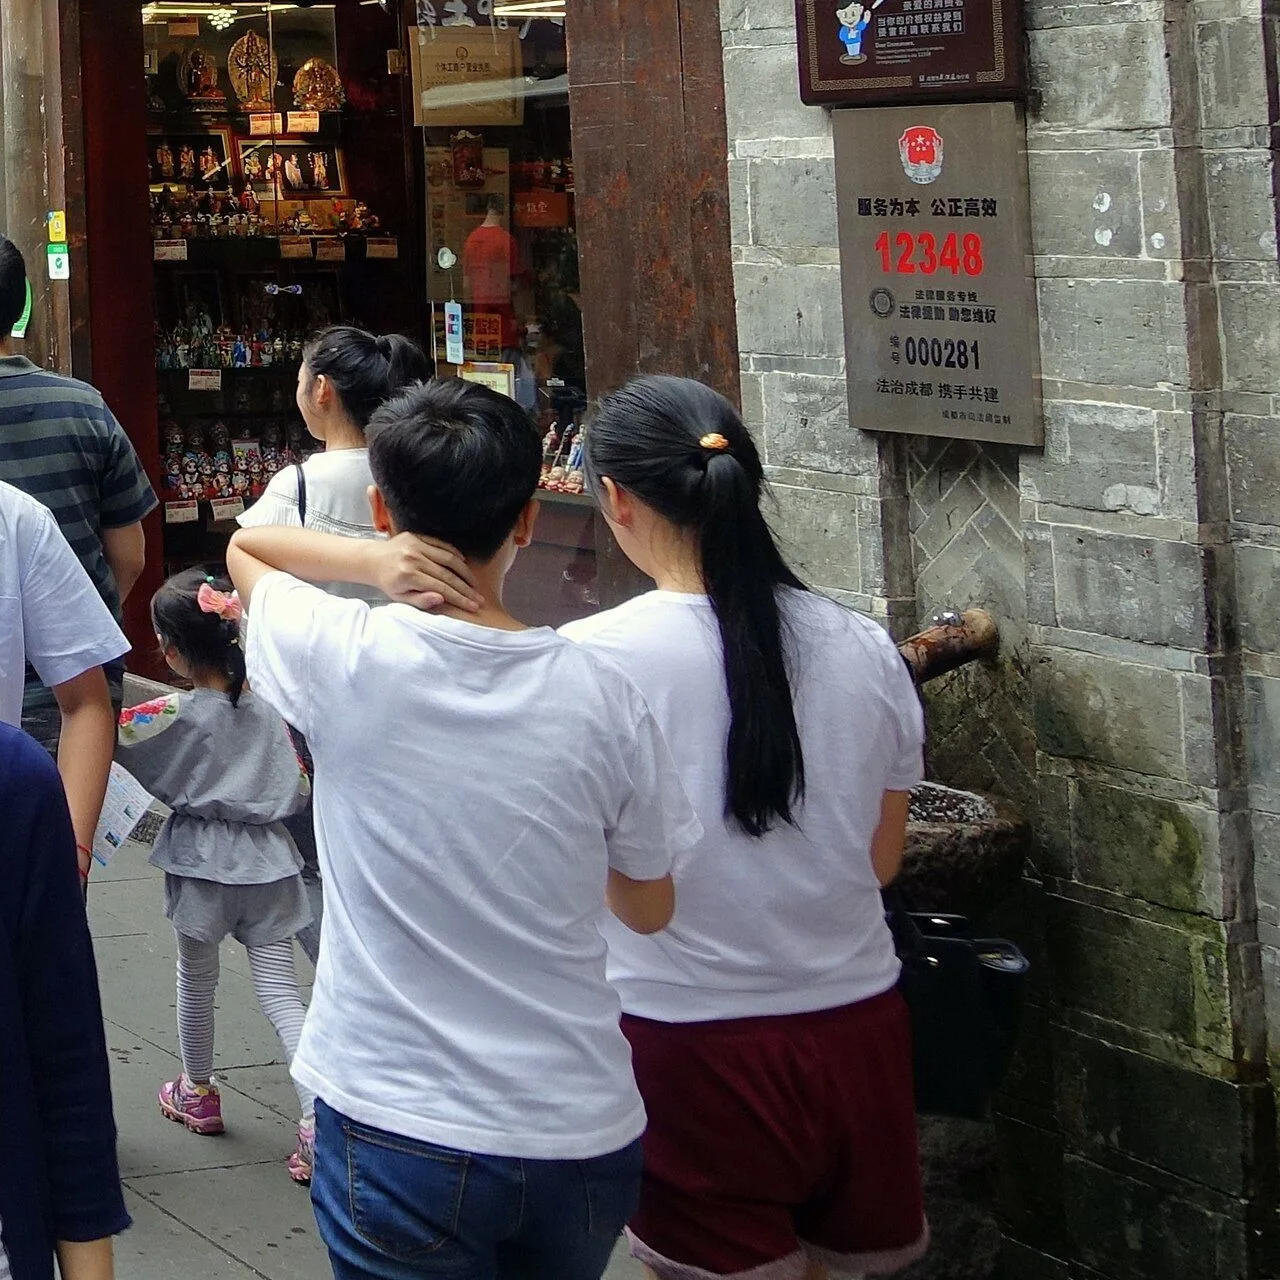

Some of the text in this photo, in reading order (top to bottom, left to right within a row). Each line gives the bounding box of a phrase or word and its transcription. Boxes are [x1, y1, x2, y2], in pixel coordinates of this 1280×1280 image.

[857, 197, 998, 218] 服务为本 公正高效
[874, 231, 985, 277] 12348
[914, 289, 978, 303] 法律服务专线
[899, 305, 997, 324] 法律援助 助您维权
[889, 335, 980, 370] 编号 000281
[876, 378, 1000, 404] 法治成都 携手共建
